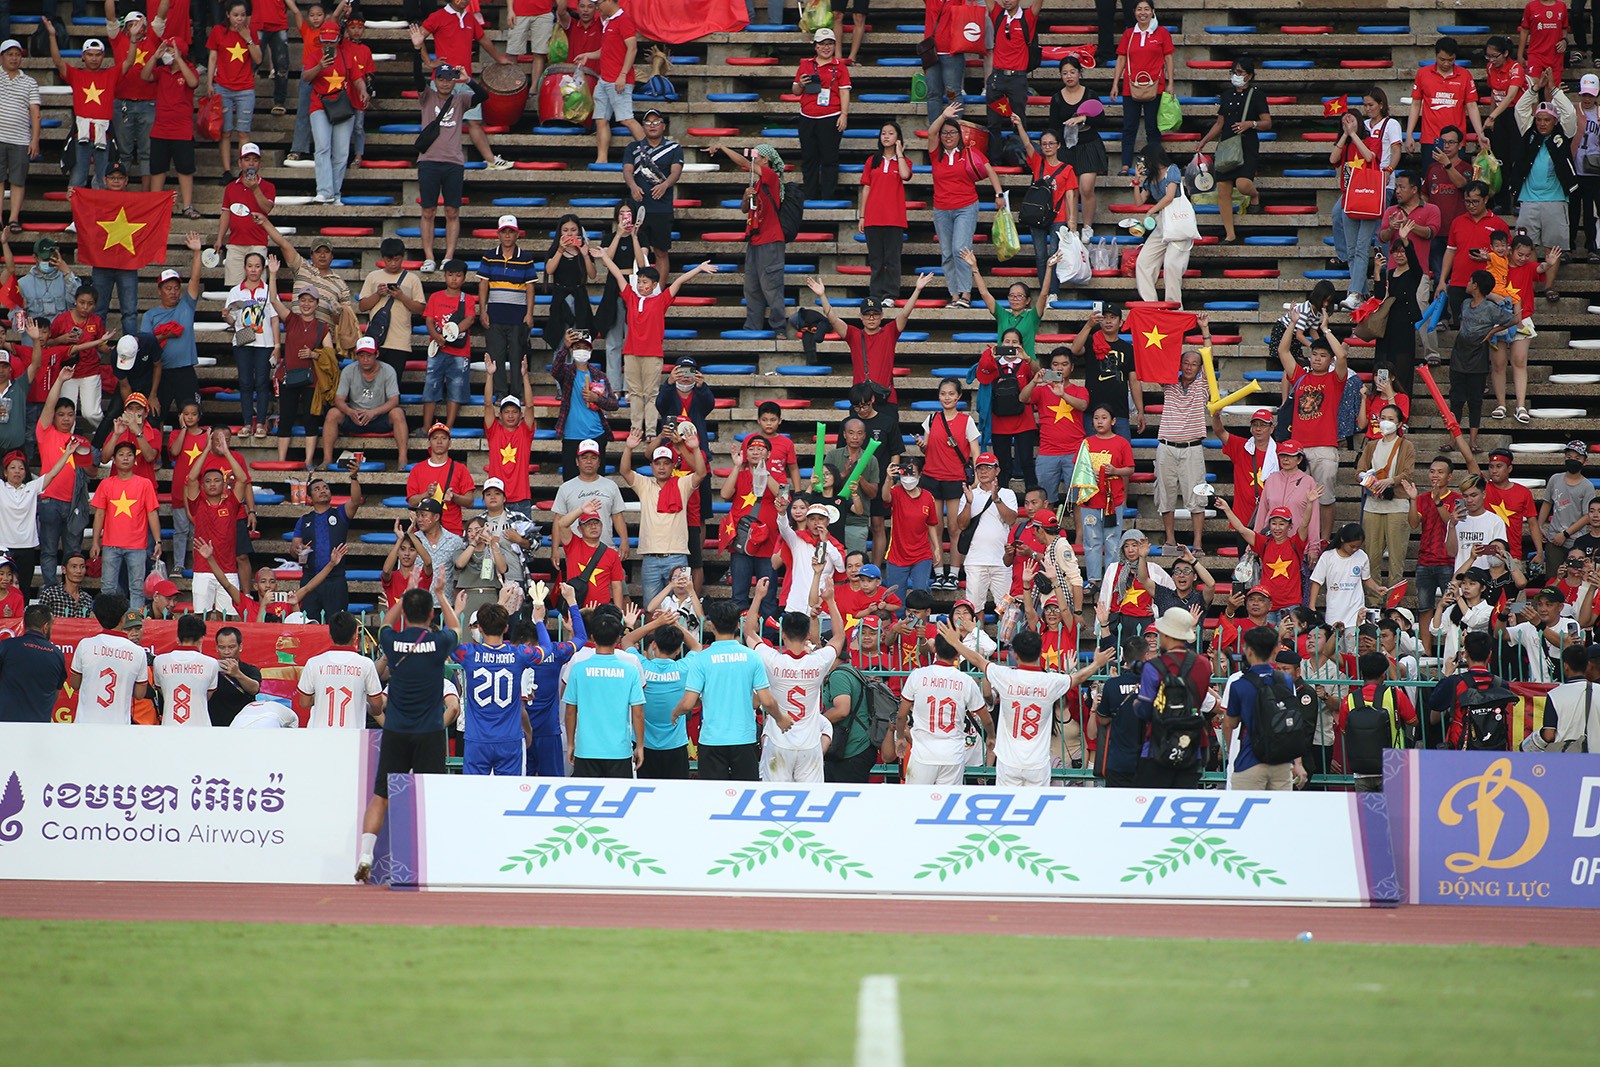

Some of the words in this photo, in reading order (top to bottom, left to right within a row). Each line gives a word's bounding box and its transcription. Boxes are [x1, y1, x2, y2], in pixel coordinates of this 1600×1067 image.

[23, 642, 54, 653] VIETNAM
[101, 646, 114, 658] DUY
[393, 641, 436, 653] VIETNAM
[482, 652, 495, 664] HUY
[496, 652, 515, 664] HOANG
[711, 653, 747, 664] VIETNAM
[170, 664, 182, 674] VAN
[344, 665, 361, 676] TRONG
[586, 667, 625, 678] VIETNAM
[644, 669, 680, 681] VIETNAM
[97, 667, 117, 708] 3
[473, 666, 514, 709] 20
[173, 683, 191, 724] 8
[325, 685, 352, 727] 17
[927, 695, 956, 733] 10
[1011, 701, 1041, 741] 18
[502, 784, 656, 819] FBT
[708, 789, 861, 823] FBT
[914, 793, 1067, 826] FBT
[1120, 796, 1272, 830] FBT
[41, 821, 180, 843] Cambodia
[187, 824, 285, 848] Airways
[1438, 876, 1501, 900] ĐỘNG
[1506, 880, 1550, 901] LỰC
